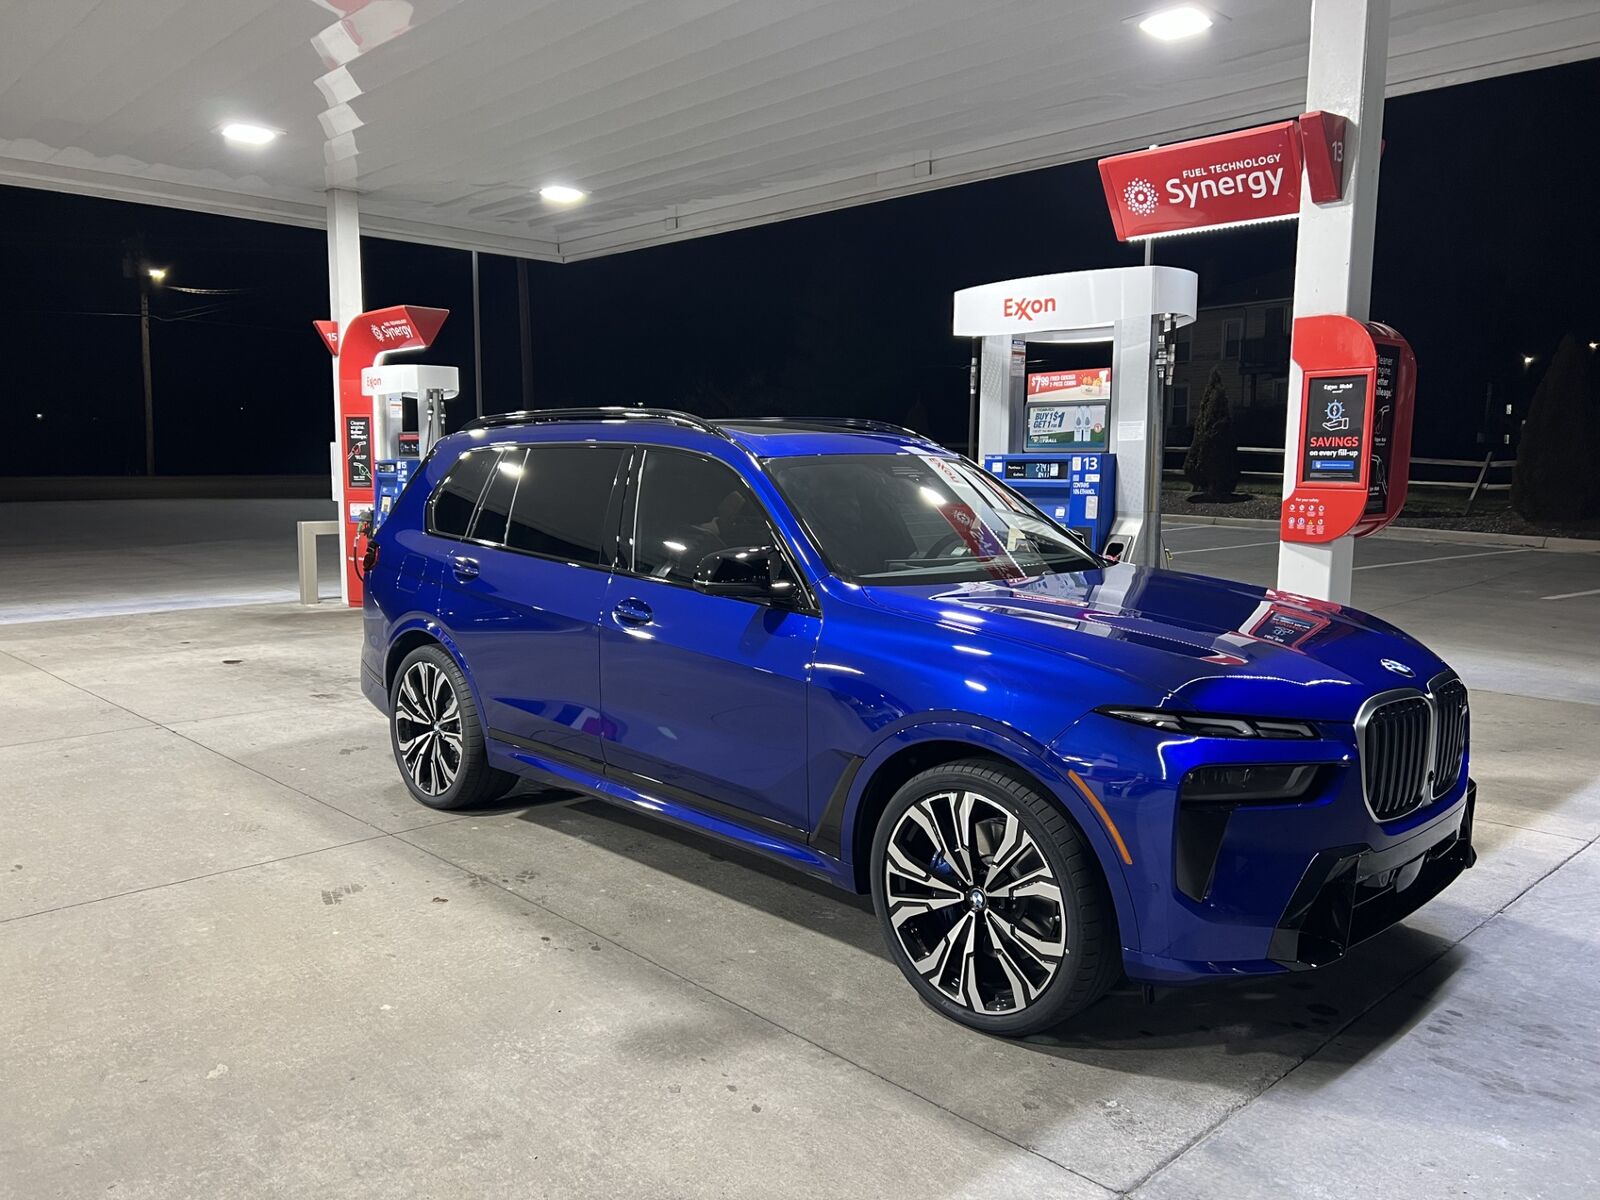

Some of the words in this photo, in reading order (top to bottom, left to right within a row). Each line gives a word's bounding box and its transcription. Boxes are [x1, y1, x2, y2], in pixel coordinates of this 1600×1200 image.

[1332, 141, 1343, 162] 13
[1183, 167, 1207, 179] FUEL
[1209, 153, 1281, 173] TECHNOLOGY
[1165, 167, 1284, 208] Synergy
[1004, 297, 1056, 321] Exxon
[327, 332, 338, 341] 15
[381, 324, 413, 340] Synergy
[1378, 354, 1393, 365] leaner
[367, 376, 382, 388] Exxon
[1035, 412, 1050, 421] BUY
[1034, 420, 1048, 429] GET
[1310, 436, 1359, 447] SAVINGS
[1318, 450, 1337, 458] every
[1337, 448, 1358, 458] fill-up
[1083, 456, 1098, 470] 13
